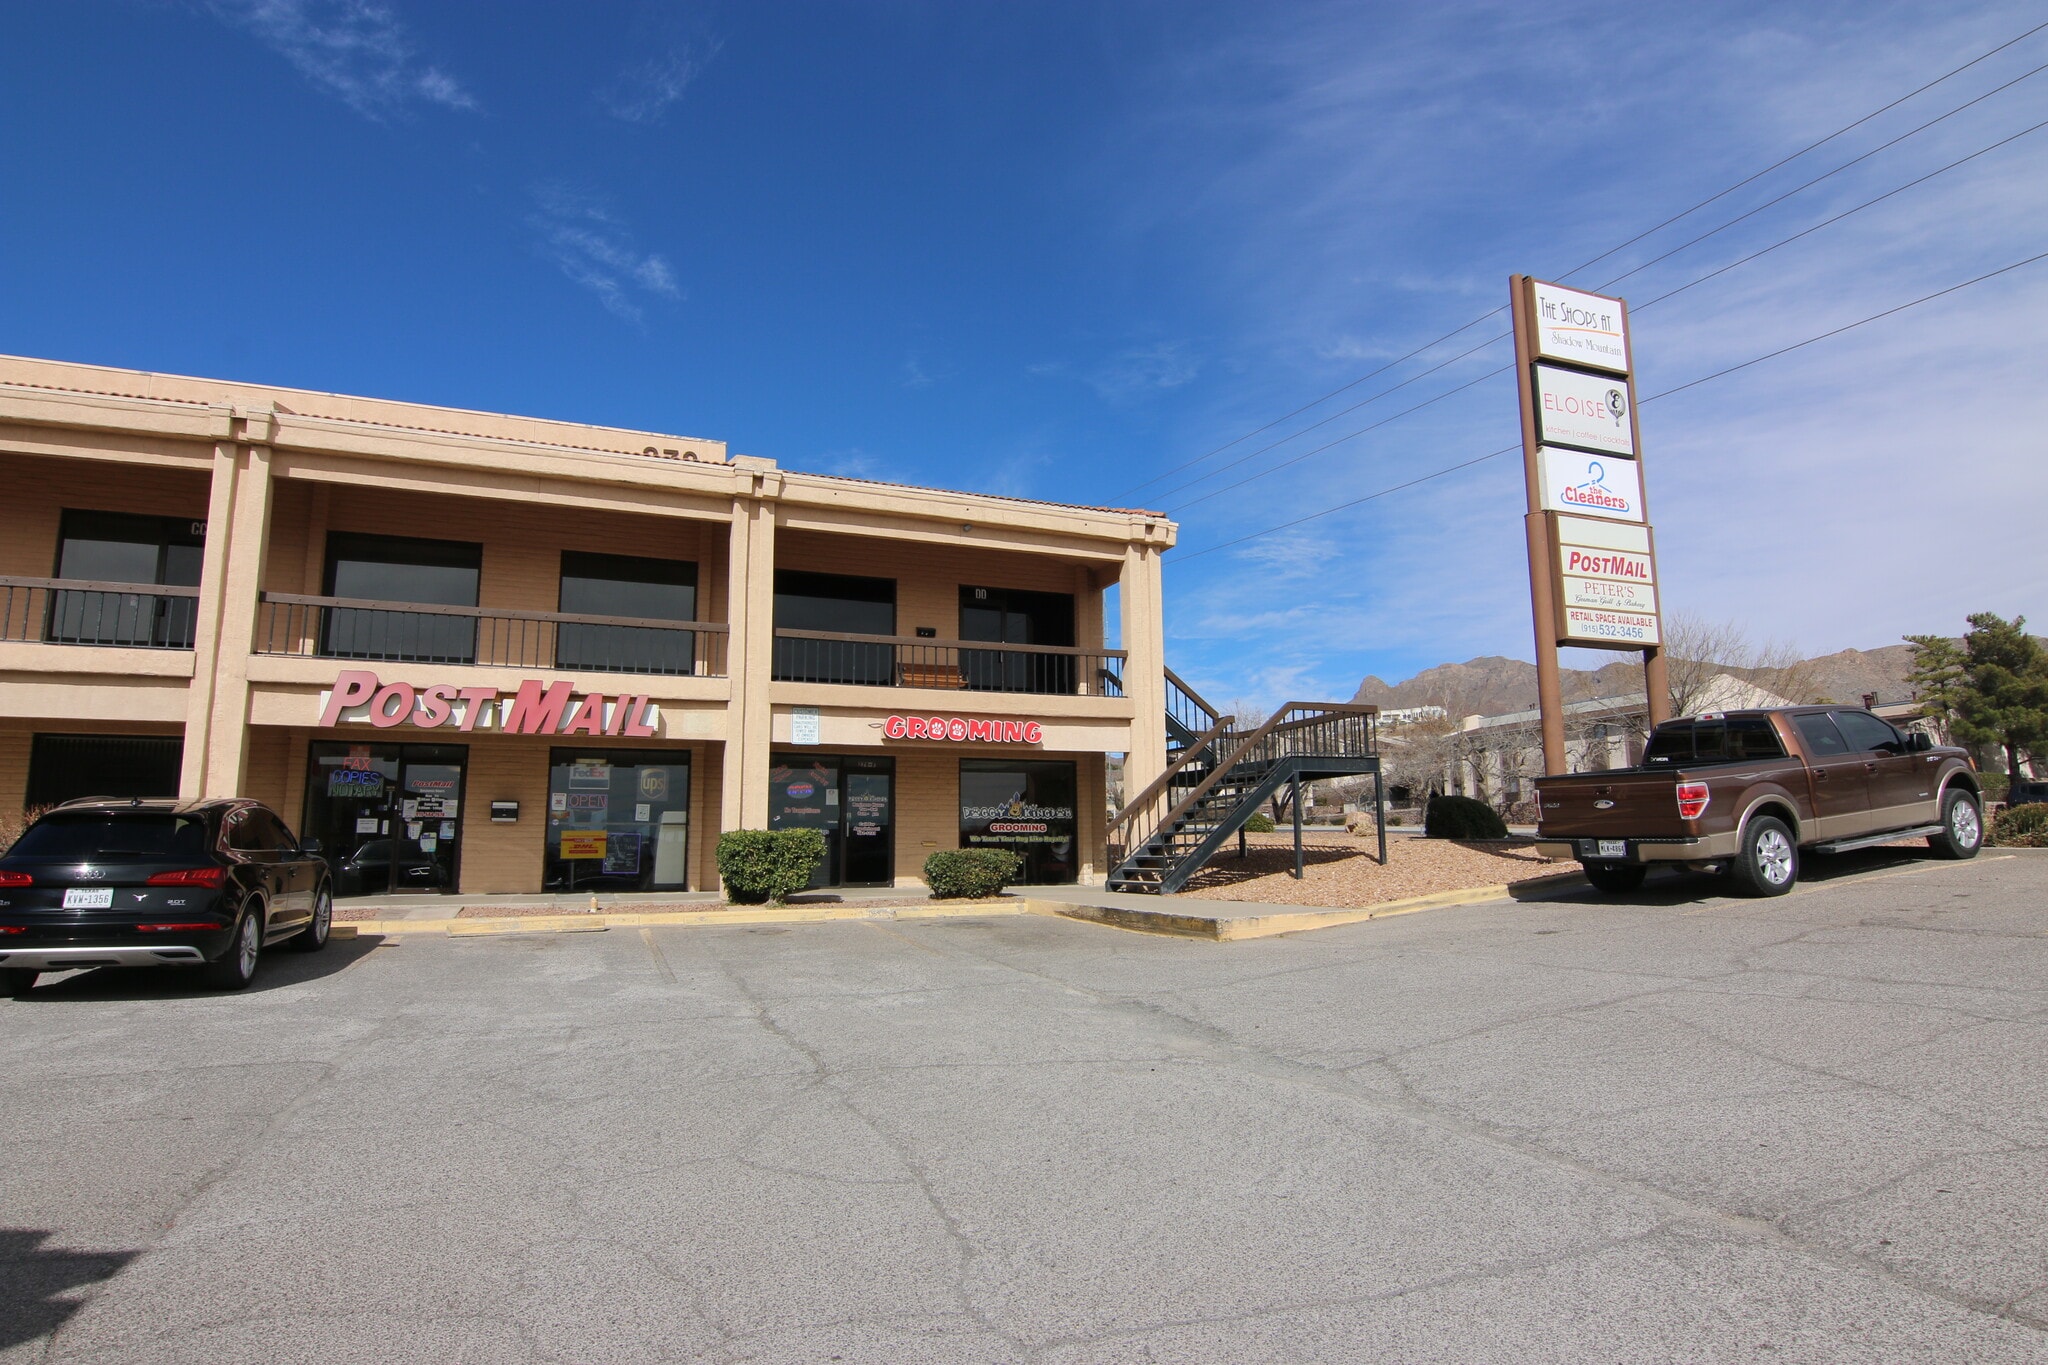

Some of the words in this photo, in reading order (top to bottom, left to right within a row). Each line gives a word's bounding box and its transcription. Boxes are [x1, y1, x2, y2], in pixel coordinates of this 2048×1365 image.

[1552, 332, 1583, 348] Shadow
[1586, 338, 1622, 356] Mountain
[1544, 393, 1605, 419] ELOISE
[1546, 425, 1570, 436] kitchen
[1576, 430, 1598, 441] coffee
[1603, 435, 1630, 446] cocktails
[1565, 486, 1625, 509] Cleaners
[1589, 486, 1603, 495] the
[1584, 582, 1635, 598] PETER'S
[1574, 594, 1597, 603] German
[1599, 596, 1613, 606] Grill
[1623, 599, 1645, 609] Bakery
[1570, 611, 1594, 622] RETAIL
[1595, 613, 1616, 624] SPACE
[1618, 615, 1653, 627] AVAILABLE
[884, 715, 1043, 744] GROOMING
[343, 756, 372, 771] FAX
[333, 769, 380, 786] COPIES
[573, 767, 605, 778] FedEx
[331, 783, 380, 797] NOTARY
[642, 777, 664, 794] ups
[569, 794, 607, 808] OPEN
[990, 823, 1047, 832] GROOMING
